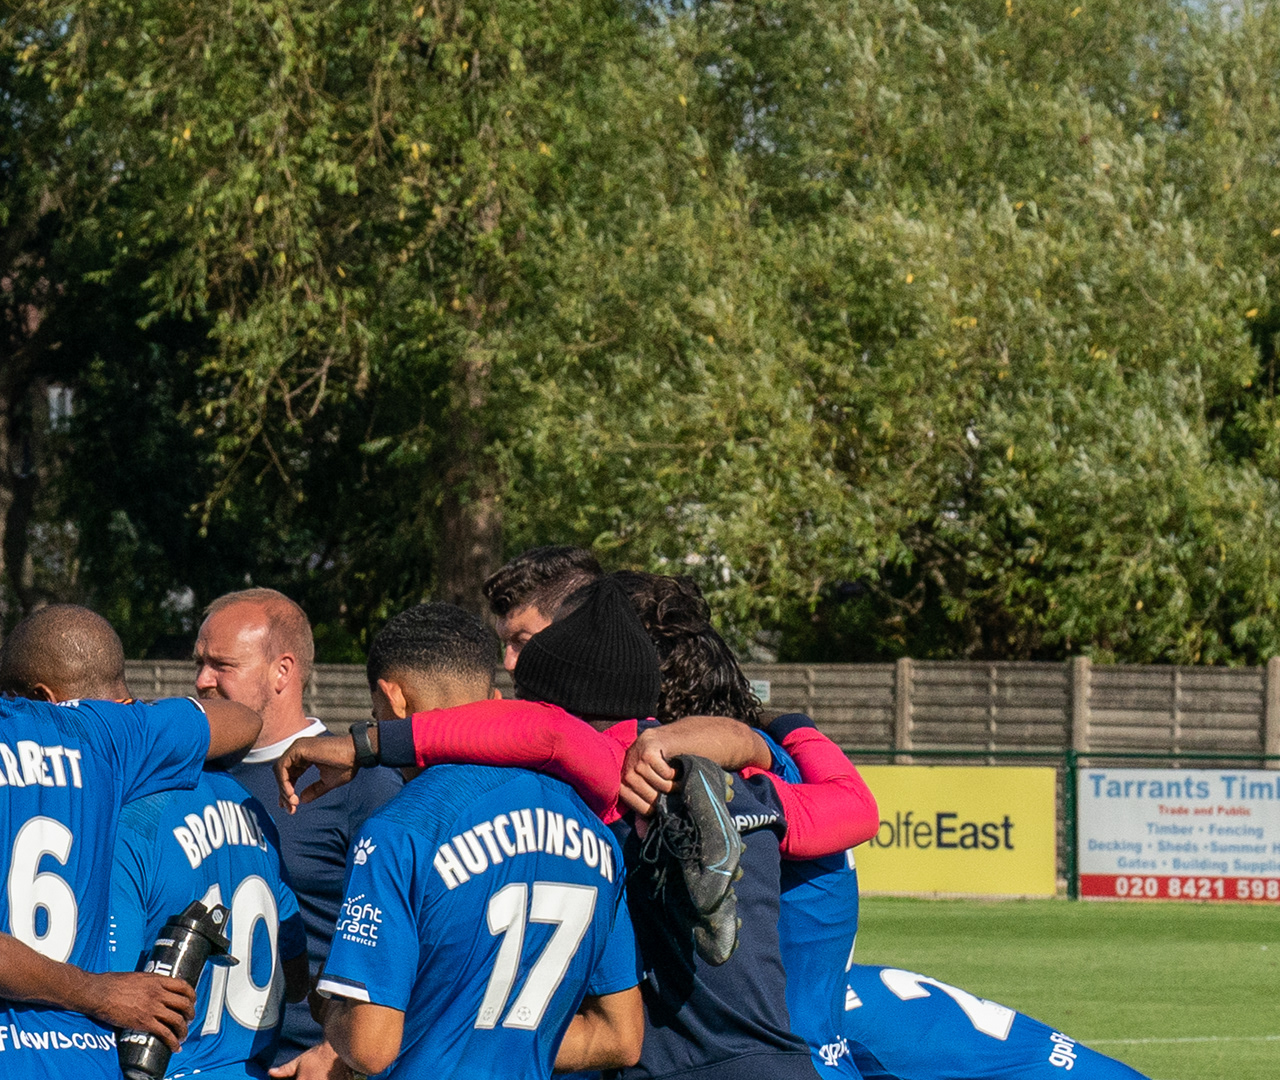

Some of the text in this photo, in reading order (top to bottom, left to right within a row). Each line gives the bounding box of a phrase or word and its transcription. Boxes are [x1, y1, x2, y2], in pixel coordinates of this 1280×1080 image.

[1089, 773, 1210, 800] Tarrants
[433, 807, 614, 891] HUTCHINSON
[870, 811, 1015, 850] olfeEast
[1088, 838, 1143, 855] Decking
[1147, 822, 1265, 839] Timber Fencing
[8, 815, 79, 964] 6
[1115, 876, 1159, 897] 020
[1167, 877, 1226, 899] 8421
[201, 875, 287, 1036] 10
[475, 881, 599, 1031] 17
